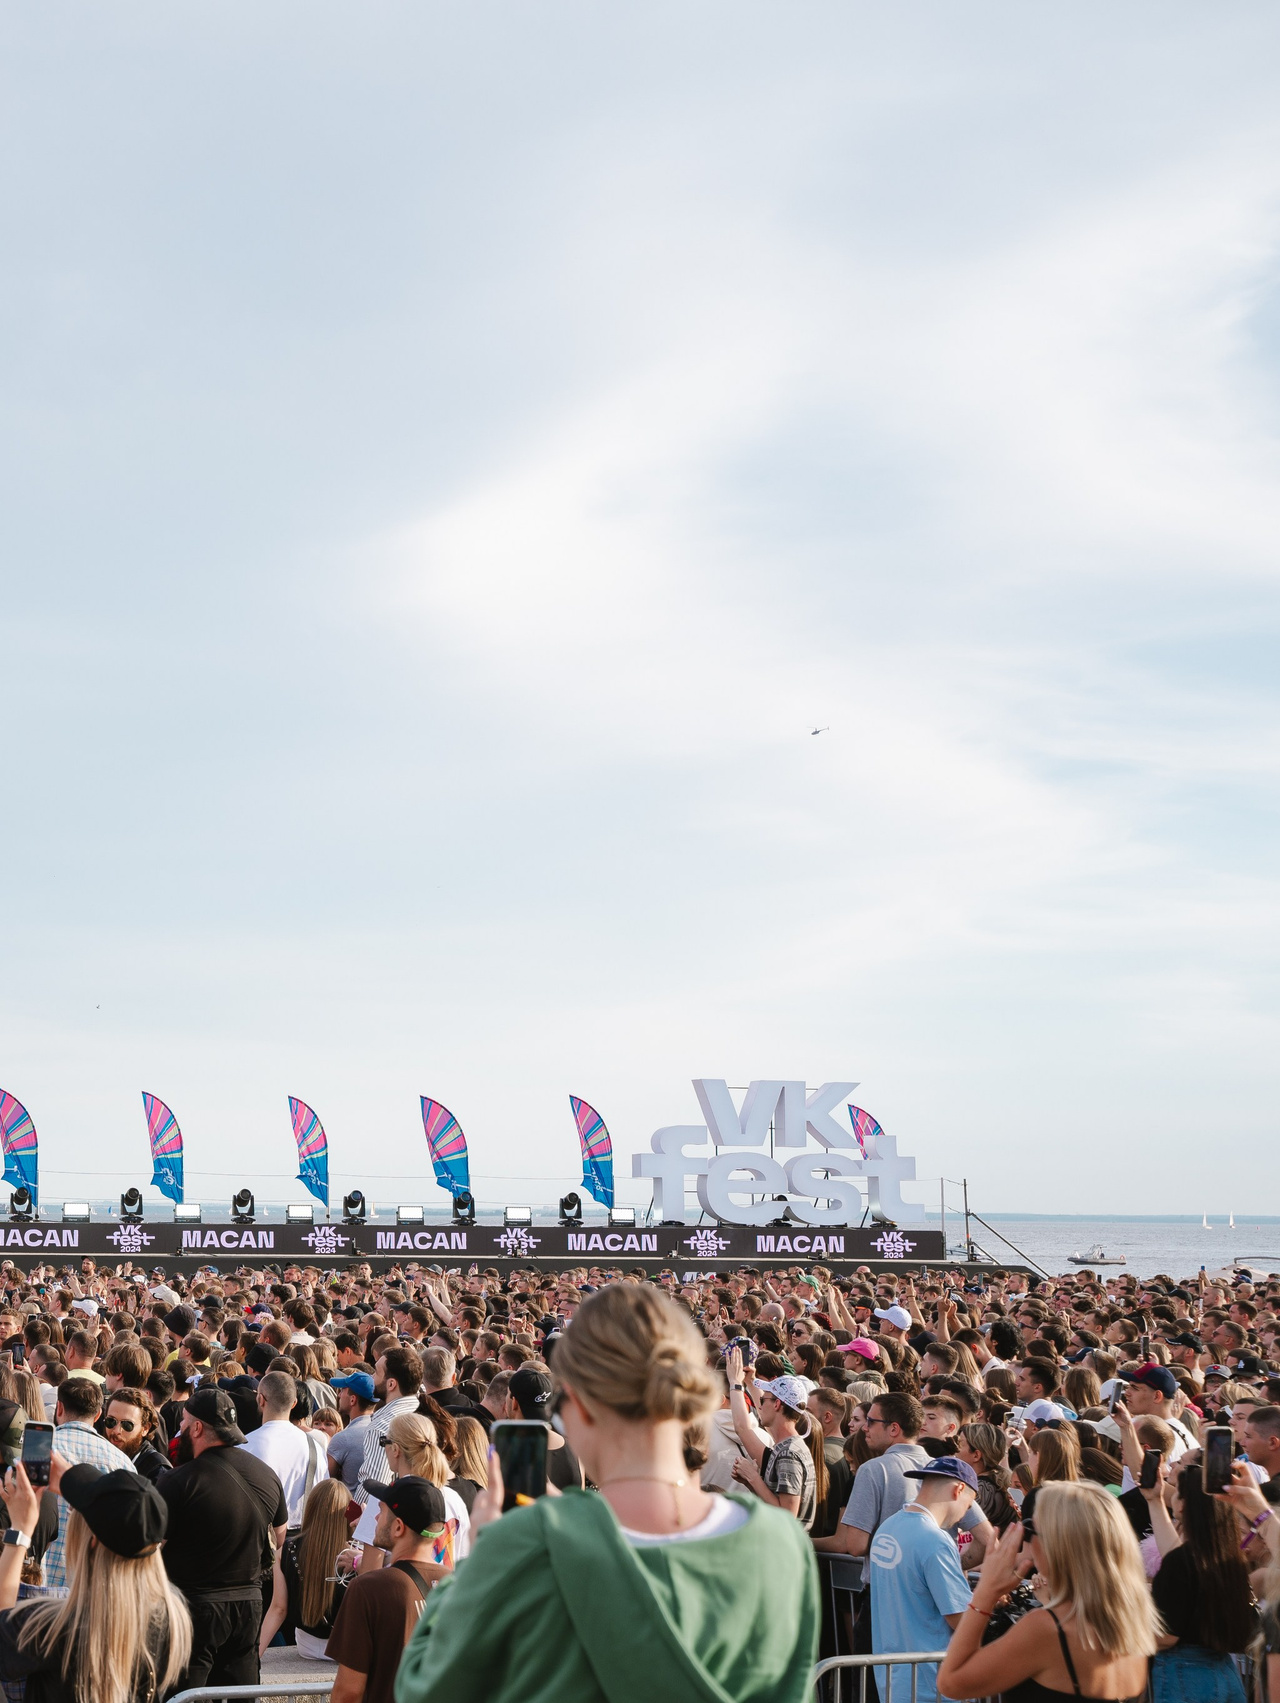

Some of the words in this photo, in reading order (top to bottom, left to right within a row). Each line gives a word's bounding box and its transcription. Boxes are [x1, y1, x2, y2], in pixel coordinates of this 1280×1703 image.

[691, 1078, 861, 1149] VK
[632, 1124, 925, 1227] fest
[119, 1224, 142, 1235] VK
[313, 1226, 336, 1237] VK
[506, 1227, 528, 1238] VK
[695, 1229, 718, 1240] VK
[882, 1231, 904, 1242] VK
[106, 1231, 156, 1246] fest
[182, 1230, 275, 1249] MACAN
[301, 1232, 350, 1247] fest
[376, 1231, 467, 1250] MACAN
[567, 1233, 658, 1252] MACAN
[683, 1236, 731, 1251] fest
[756, 1235, 845, 1253] MACAN
[870, 1237, 917, 1252] fest
